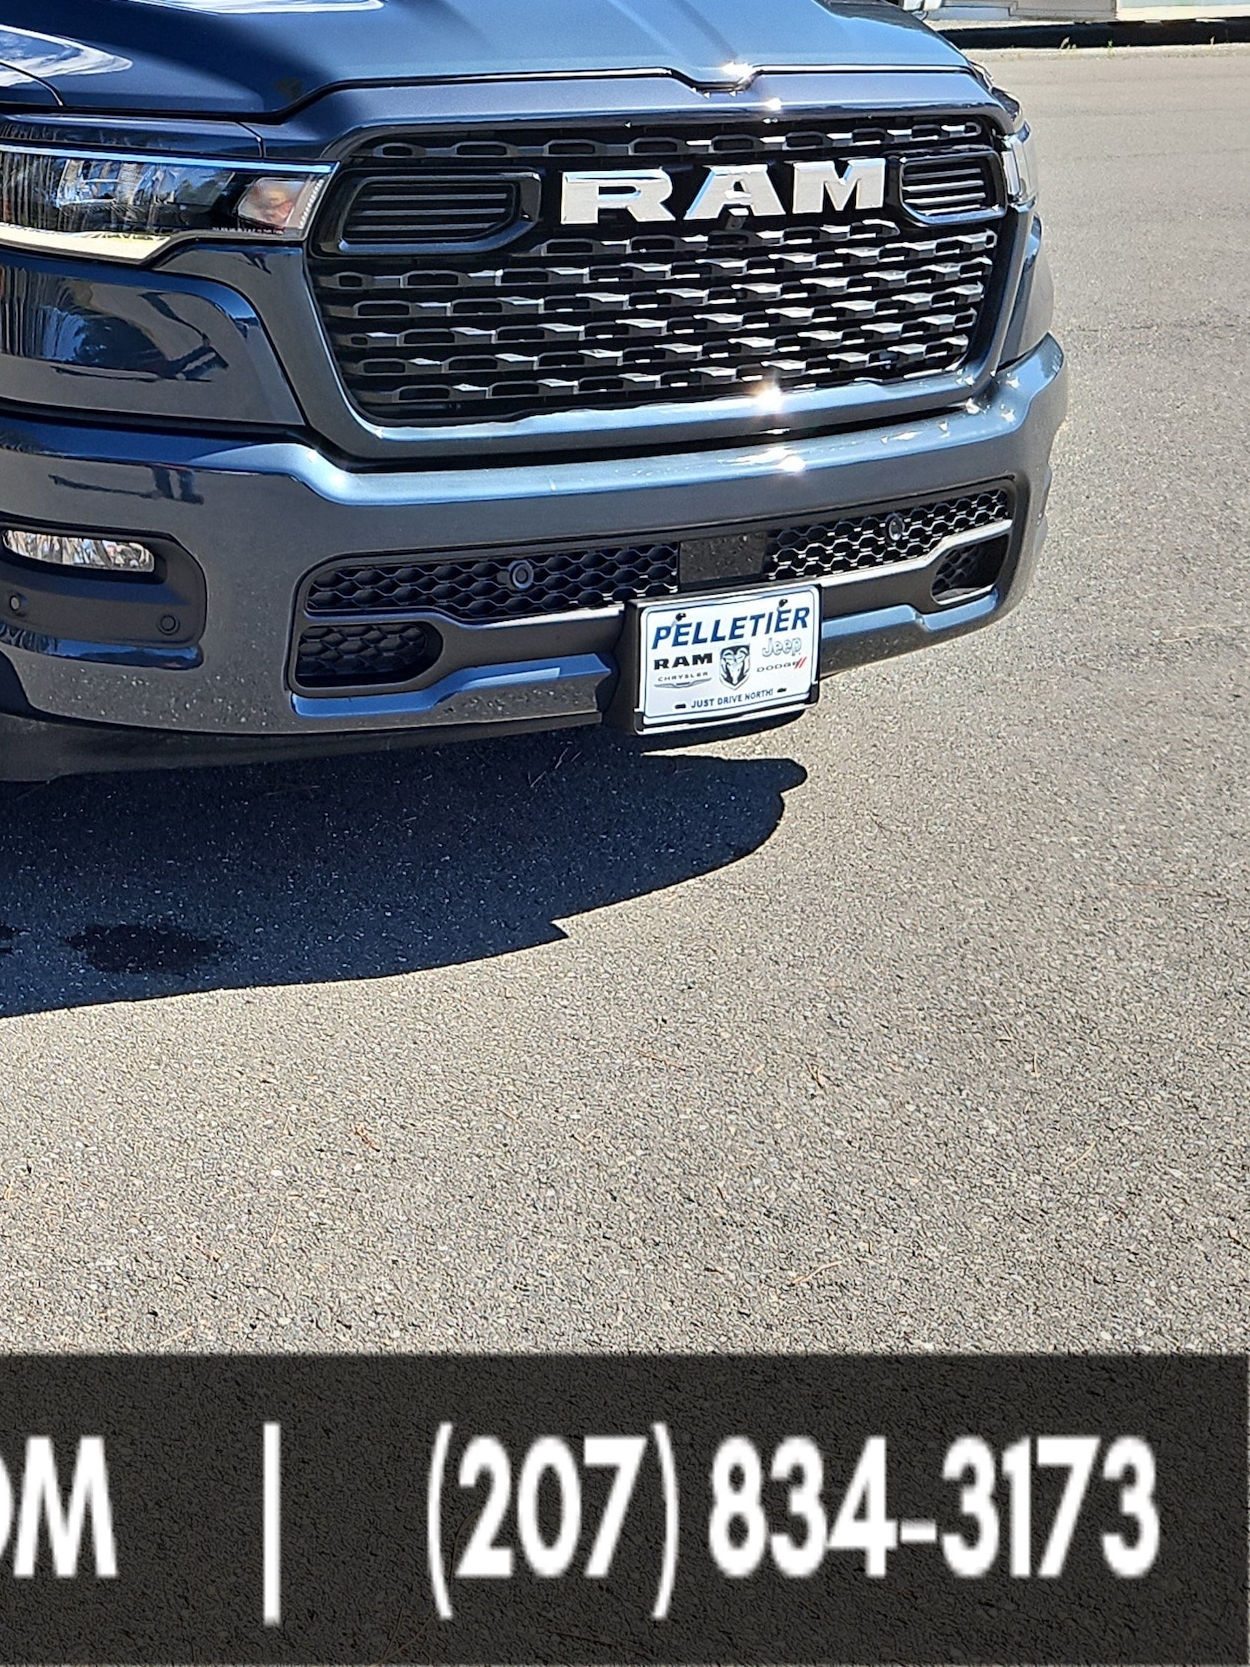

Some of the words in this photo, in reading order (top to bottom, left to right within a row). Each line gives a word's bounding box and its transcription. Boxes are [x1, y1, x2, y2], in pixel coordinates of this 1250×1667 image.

[560, 158, 886, 225] RAM
[651, 606, 810, 649] PELLETIER
[762, 637, 801, 657] Jeep
[654, 652, 713, 670] RAM
[658, 672, 708, 682] CHRYSLER
[691, 699, 714, 708] JUST
[717, 694, 742, 705] DRIVE
